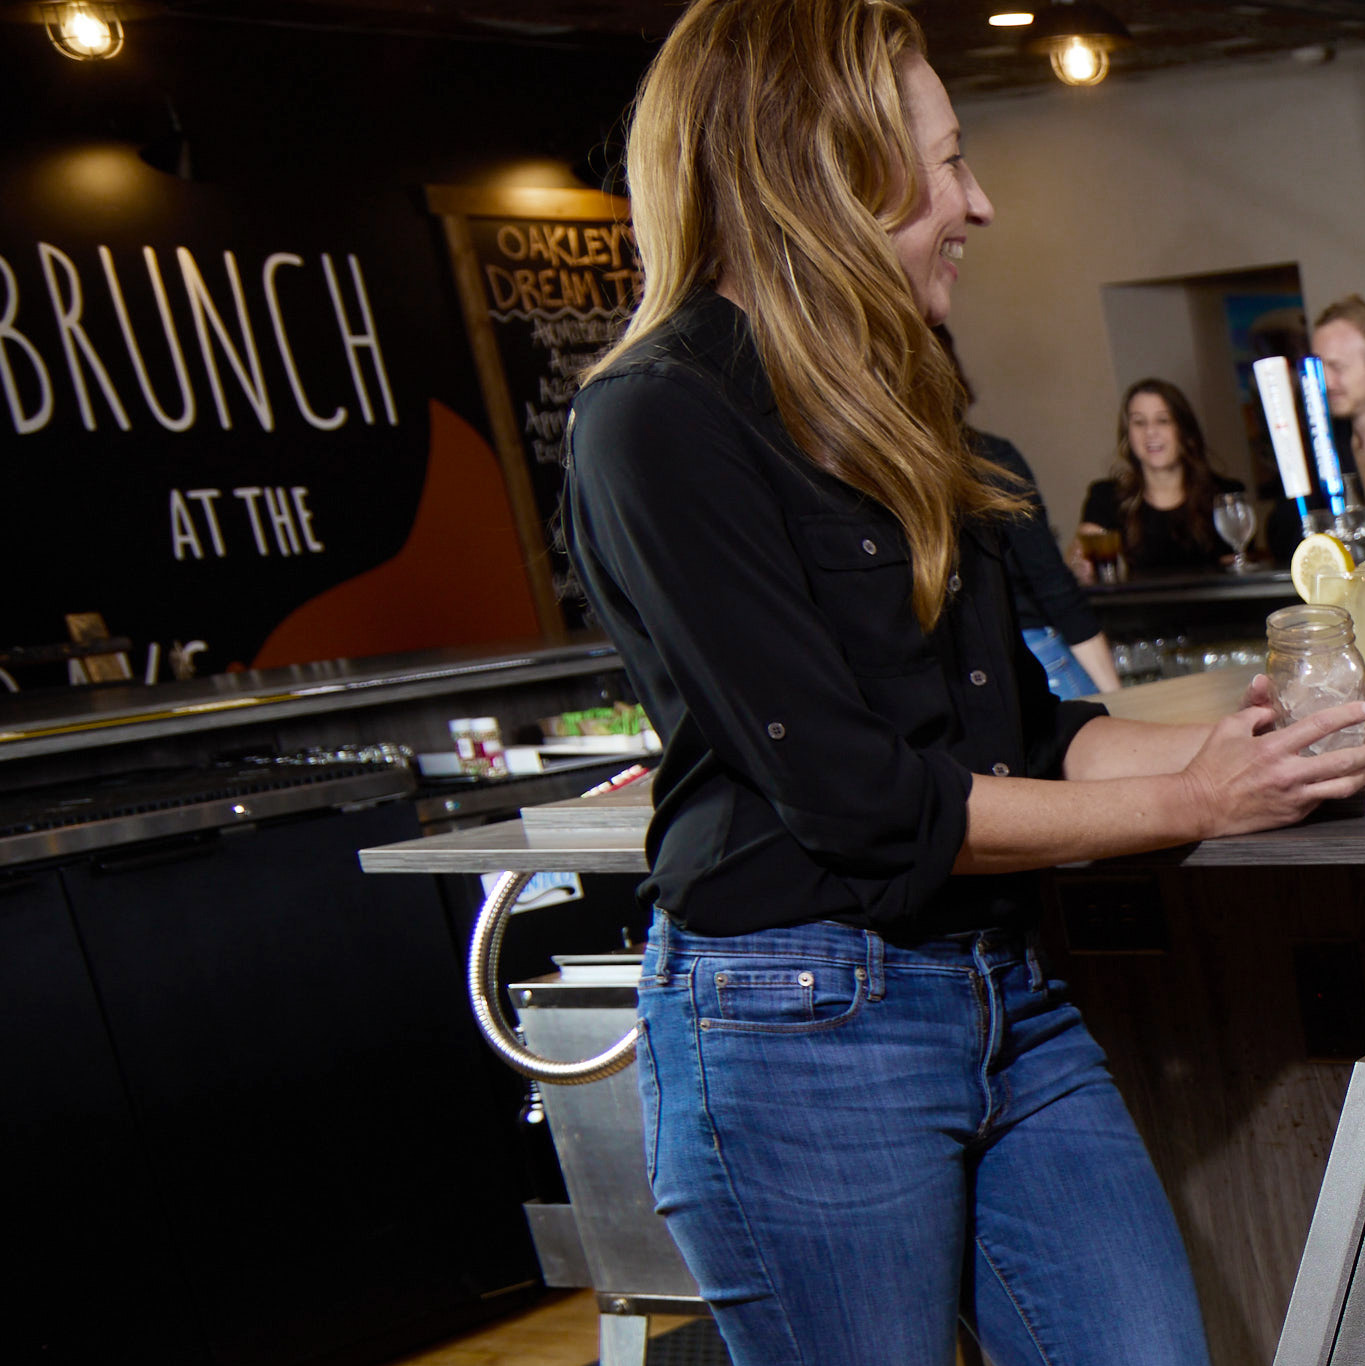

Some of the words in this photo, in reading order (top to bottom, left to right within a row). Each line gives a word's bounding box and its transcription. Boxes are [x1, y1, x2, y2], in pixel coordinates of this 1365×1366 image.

[486, 264, 602, 311] DREAM
[0, 242, 398, 433] BRUNCH
[170, 488, 226, 560] AT
[232, 486, 324, 557] THE
